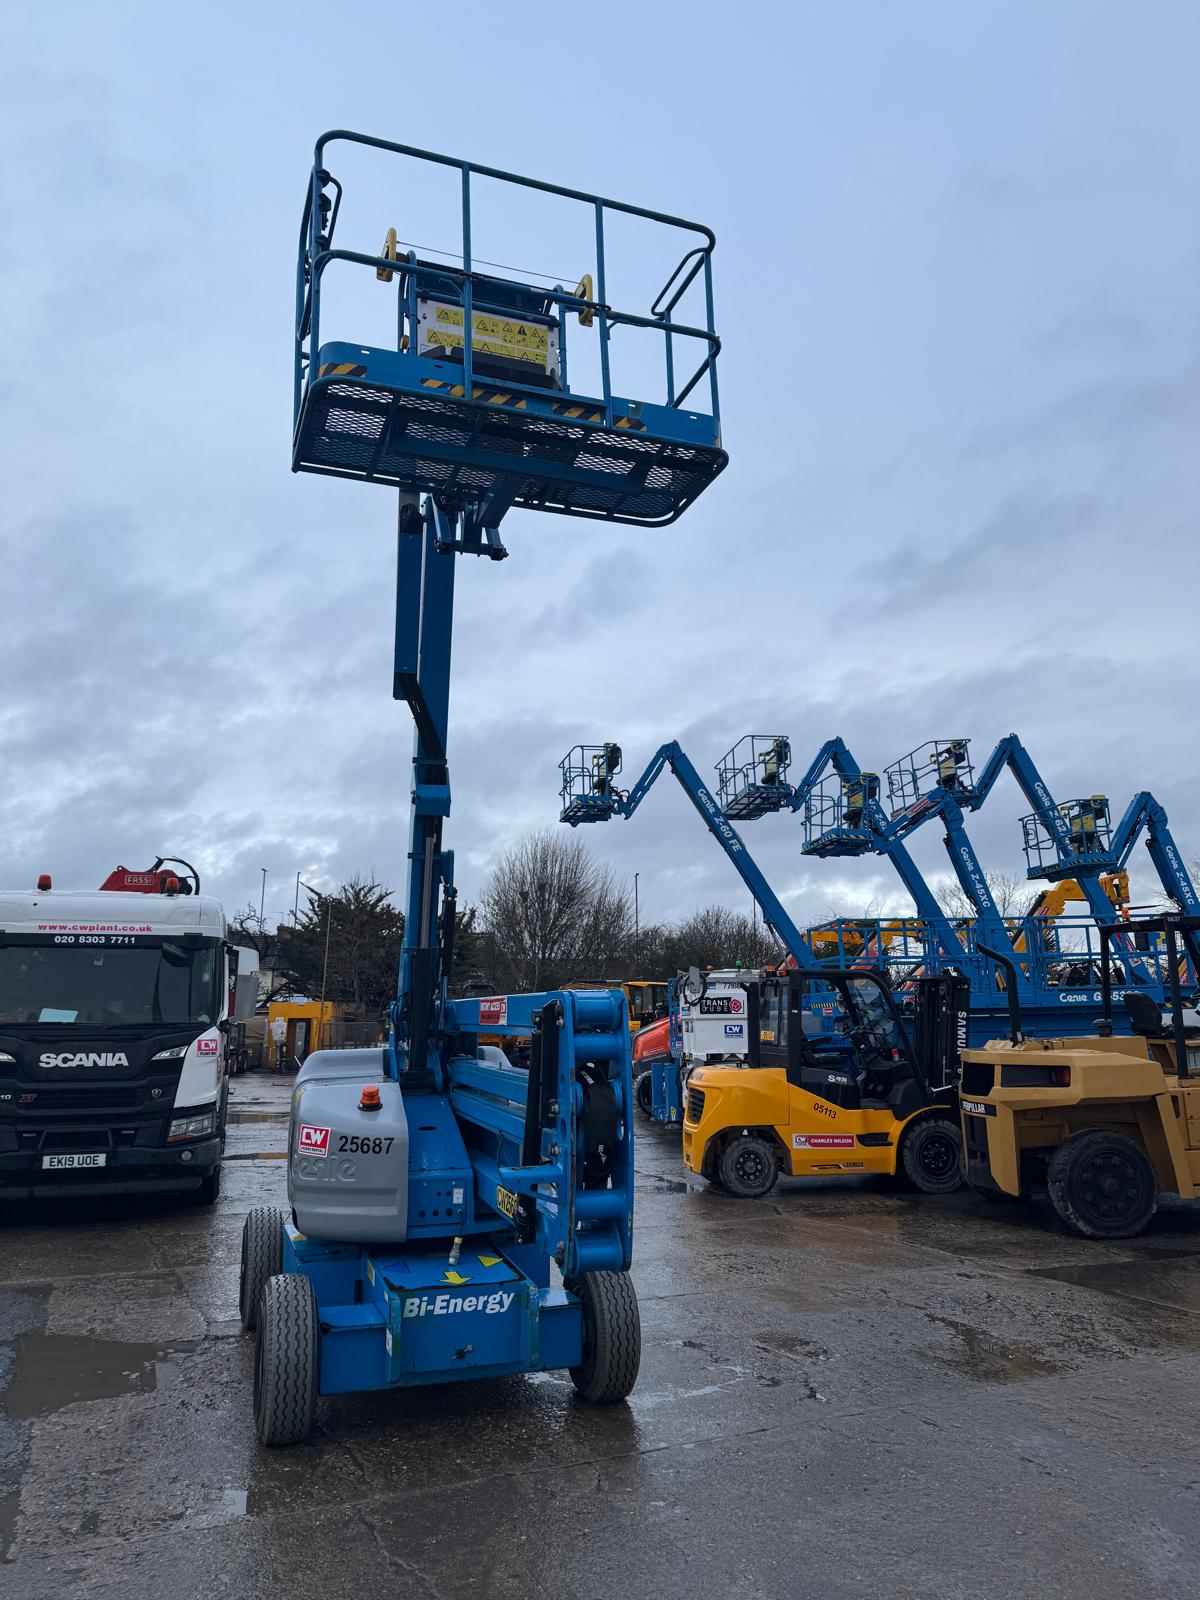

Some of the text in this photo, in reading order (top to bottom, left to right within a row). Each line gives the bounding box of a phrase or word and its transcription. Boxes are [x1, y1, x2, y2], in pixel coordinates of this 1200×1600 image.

[1034, 782, 1051, 808] Genie
[697, 788, 742, 852] Genie Z-60 FE
[127, 876, 152, 884] FASSI
[960, 846, 991, 908] Genie Z-45XC
[1165, 845, 1195, 905] Genie Z-45XC
[37, 924, 153, 933] www.cwplant.co.uk
[54, 935, 136, 944] 020 8303 7711
[1059, 993, 1088, 1002] Genie
[726, 1025, 741, 1033] CW
[201, 1040, 217, 1050] CW
[38, 1052, 129, 1068] SCANIA
[813, 1102, 837, 1119] 05113
[301, 1127, 326, 1145] CW
[338, 1135, 395, 1155] 25687
[49, 1155, 100, 1167] EK19 UOE
[402, 1290, 516, 1319] Bi-Energy
